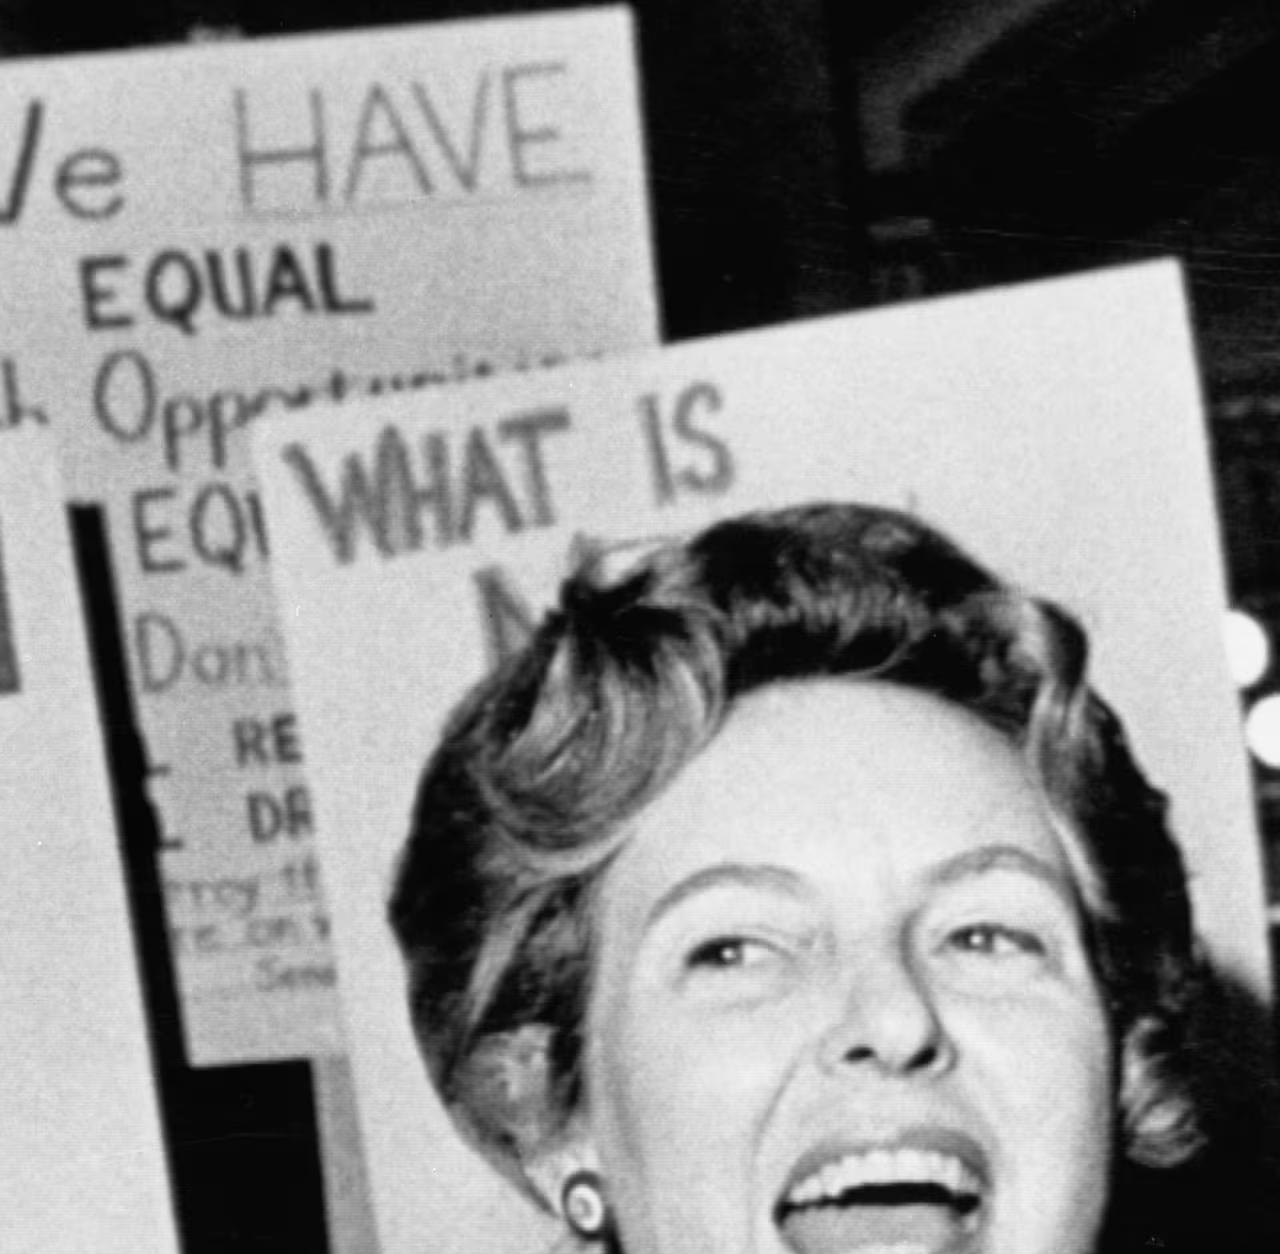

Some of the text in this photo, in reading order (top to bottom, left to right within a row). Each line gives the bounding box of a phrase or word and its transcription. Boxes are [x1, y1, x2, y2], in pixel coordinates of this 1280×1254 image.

[234, 62, 593, 204] HAVE
[78, 242, 376, 335] EQUAL
[282, 408, 572, 566] WHAT
[640, 378, 735, 508] IS
